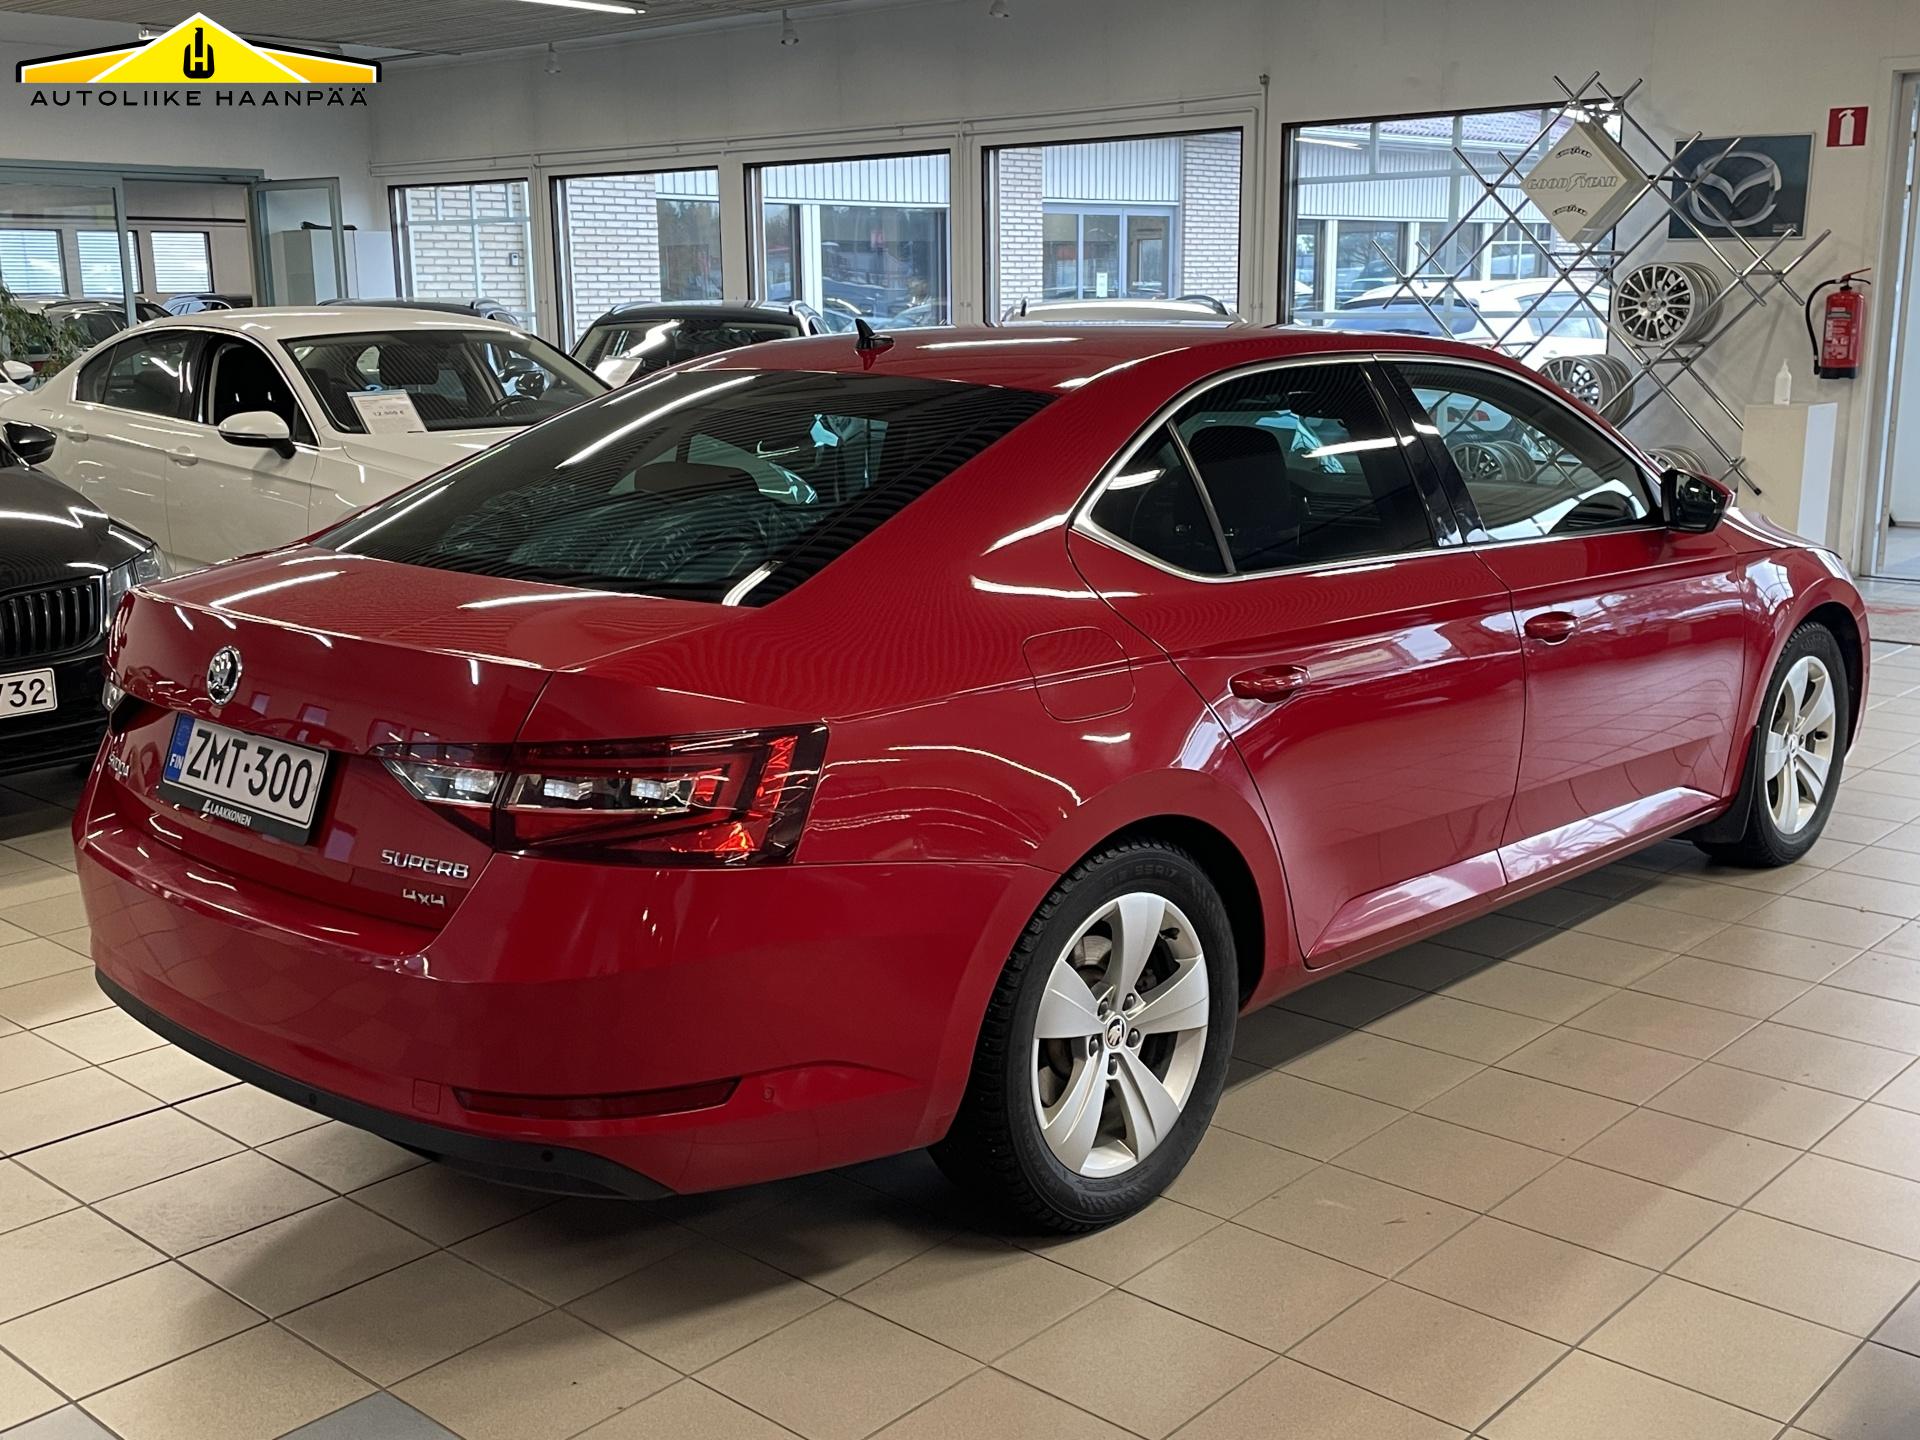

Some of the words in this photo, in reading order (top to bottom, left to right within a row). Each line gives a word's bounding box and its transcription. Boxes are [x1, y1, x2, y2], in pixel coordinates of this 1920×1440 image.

[1527, 172, 1618, 192] GOODYEAR
[0, 678, 47, 707] 32
[169, 753, 184, 770] FIN
[210, 806, 252, 827] LAAKKONEN
[380, 849, 469, 879] SUPERB
